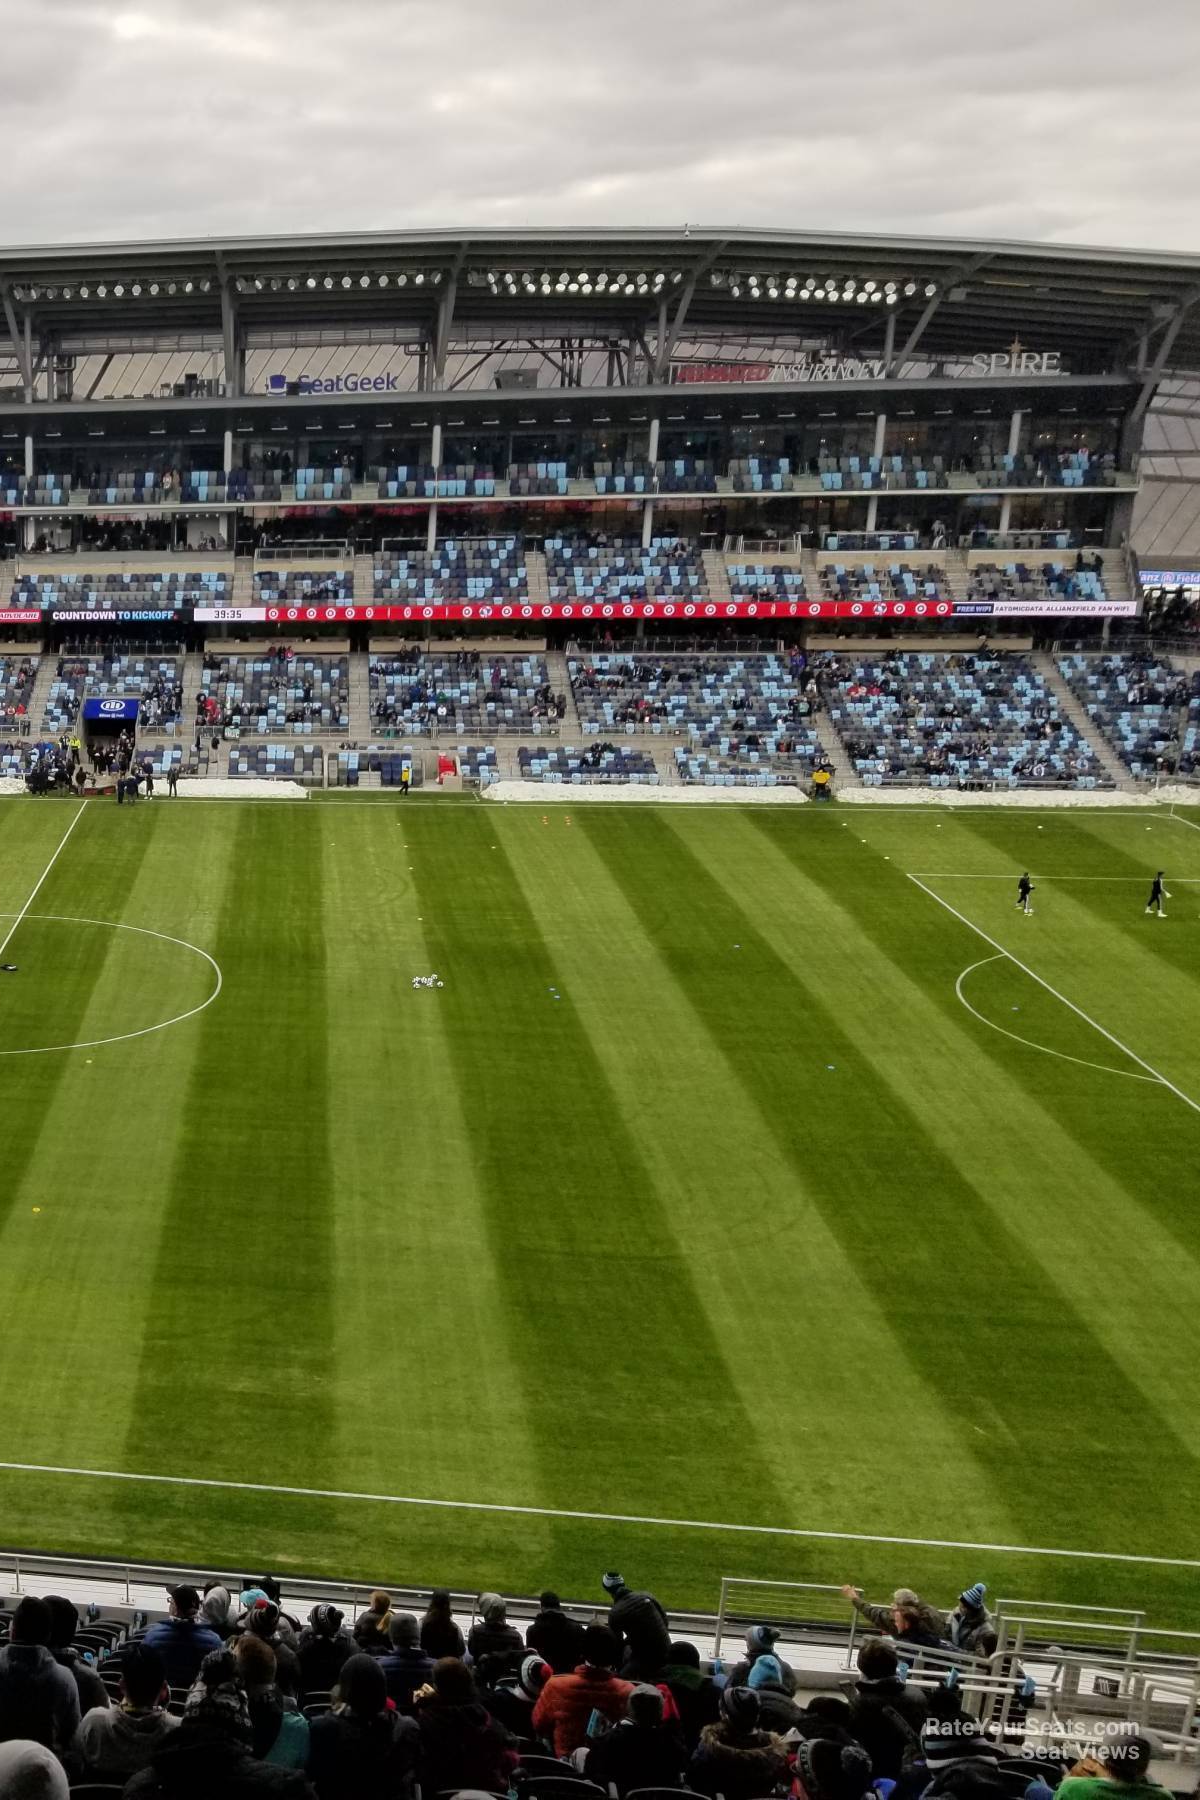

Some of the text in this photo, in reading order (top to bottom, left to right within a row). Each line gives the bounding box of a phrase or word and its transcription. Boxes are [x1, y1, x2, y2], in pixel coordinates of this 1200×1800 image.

[972, 352, 1061, 377] SPIRE
[298, 372, 399, 394] SeatGeek
[52, 610, 116, 621] COUNTDOWN
[117, 610, 131, 620] TO
[214, 609, 242, 619] 39:35
